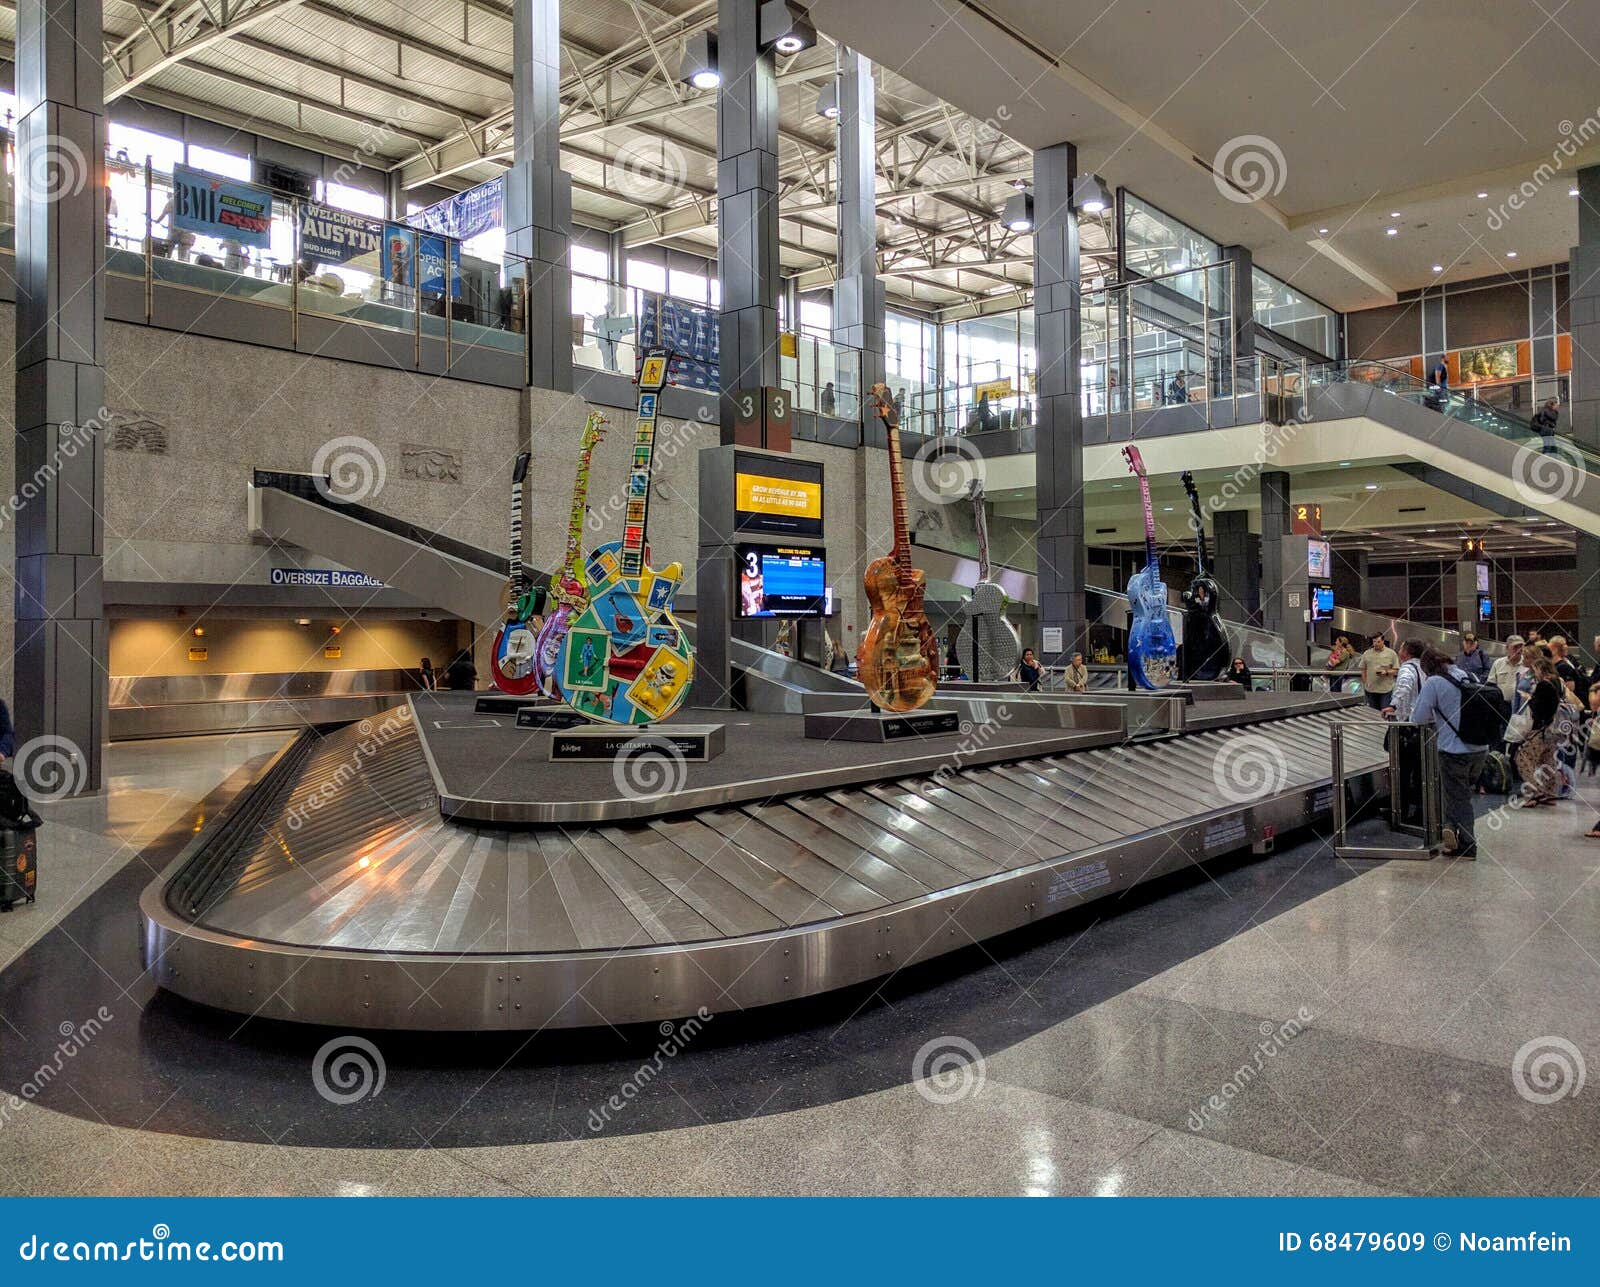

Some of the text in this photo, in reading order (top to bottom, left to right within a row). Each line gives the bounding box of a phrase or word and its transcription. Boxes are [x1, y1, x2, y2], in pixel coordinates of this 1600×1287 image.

[175, 182, 215, 224] BMI
[307, 205, 365, 229] WELCOME
[302, 216, 382, 252] AUSTIN
[303, 242, 320, 253] BUD
[320, 246, 341, 257] LIGHT
[418, 252, 458, 270] OPENIG
[742, 396, 754, 418] 3
[774, 396, 785, 418] 3
[1298, 507, 1307, 520] 2
[746, 552, 758, 578] 3
[272, 569, 329, 585] OVERSIZE
